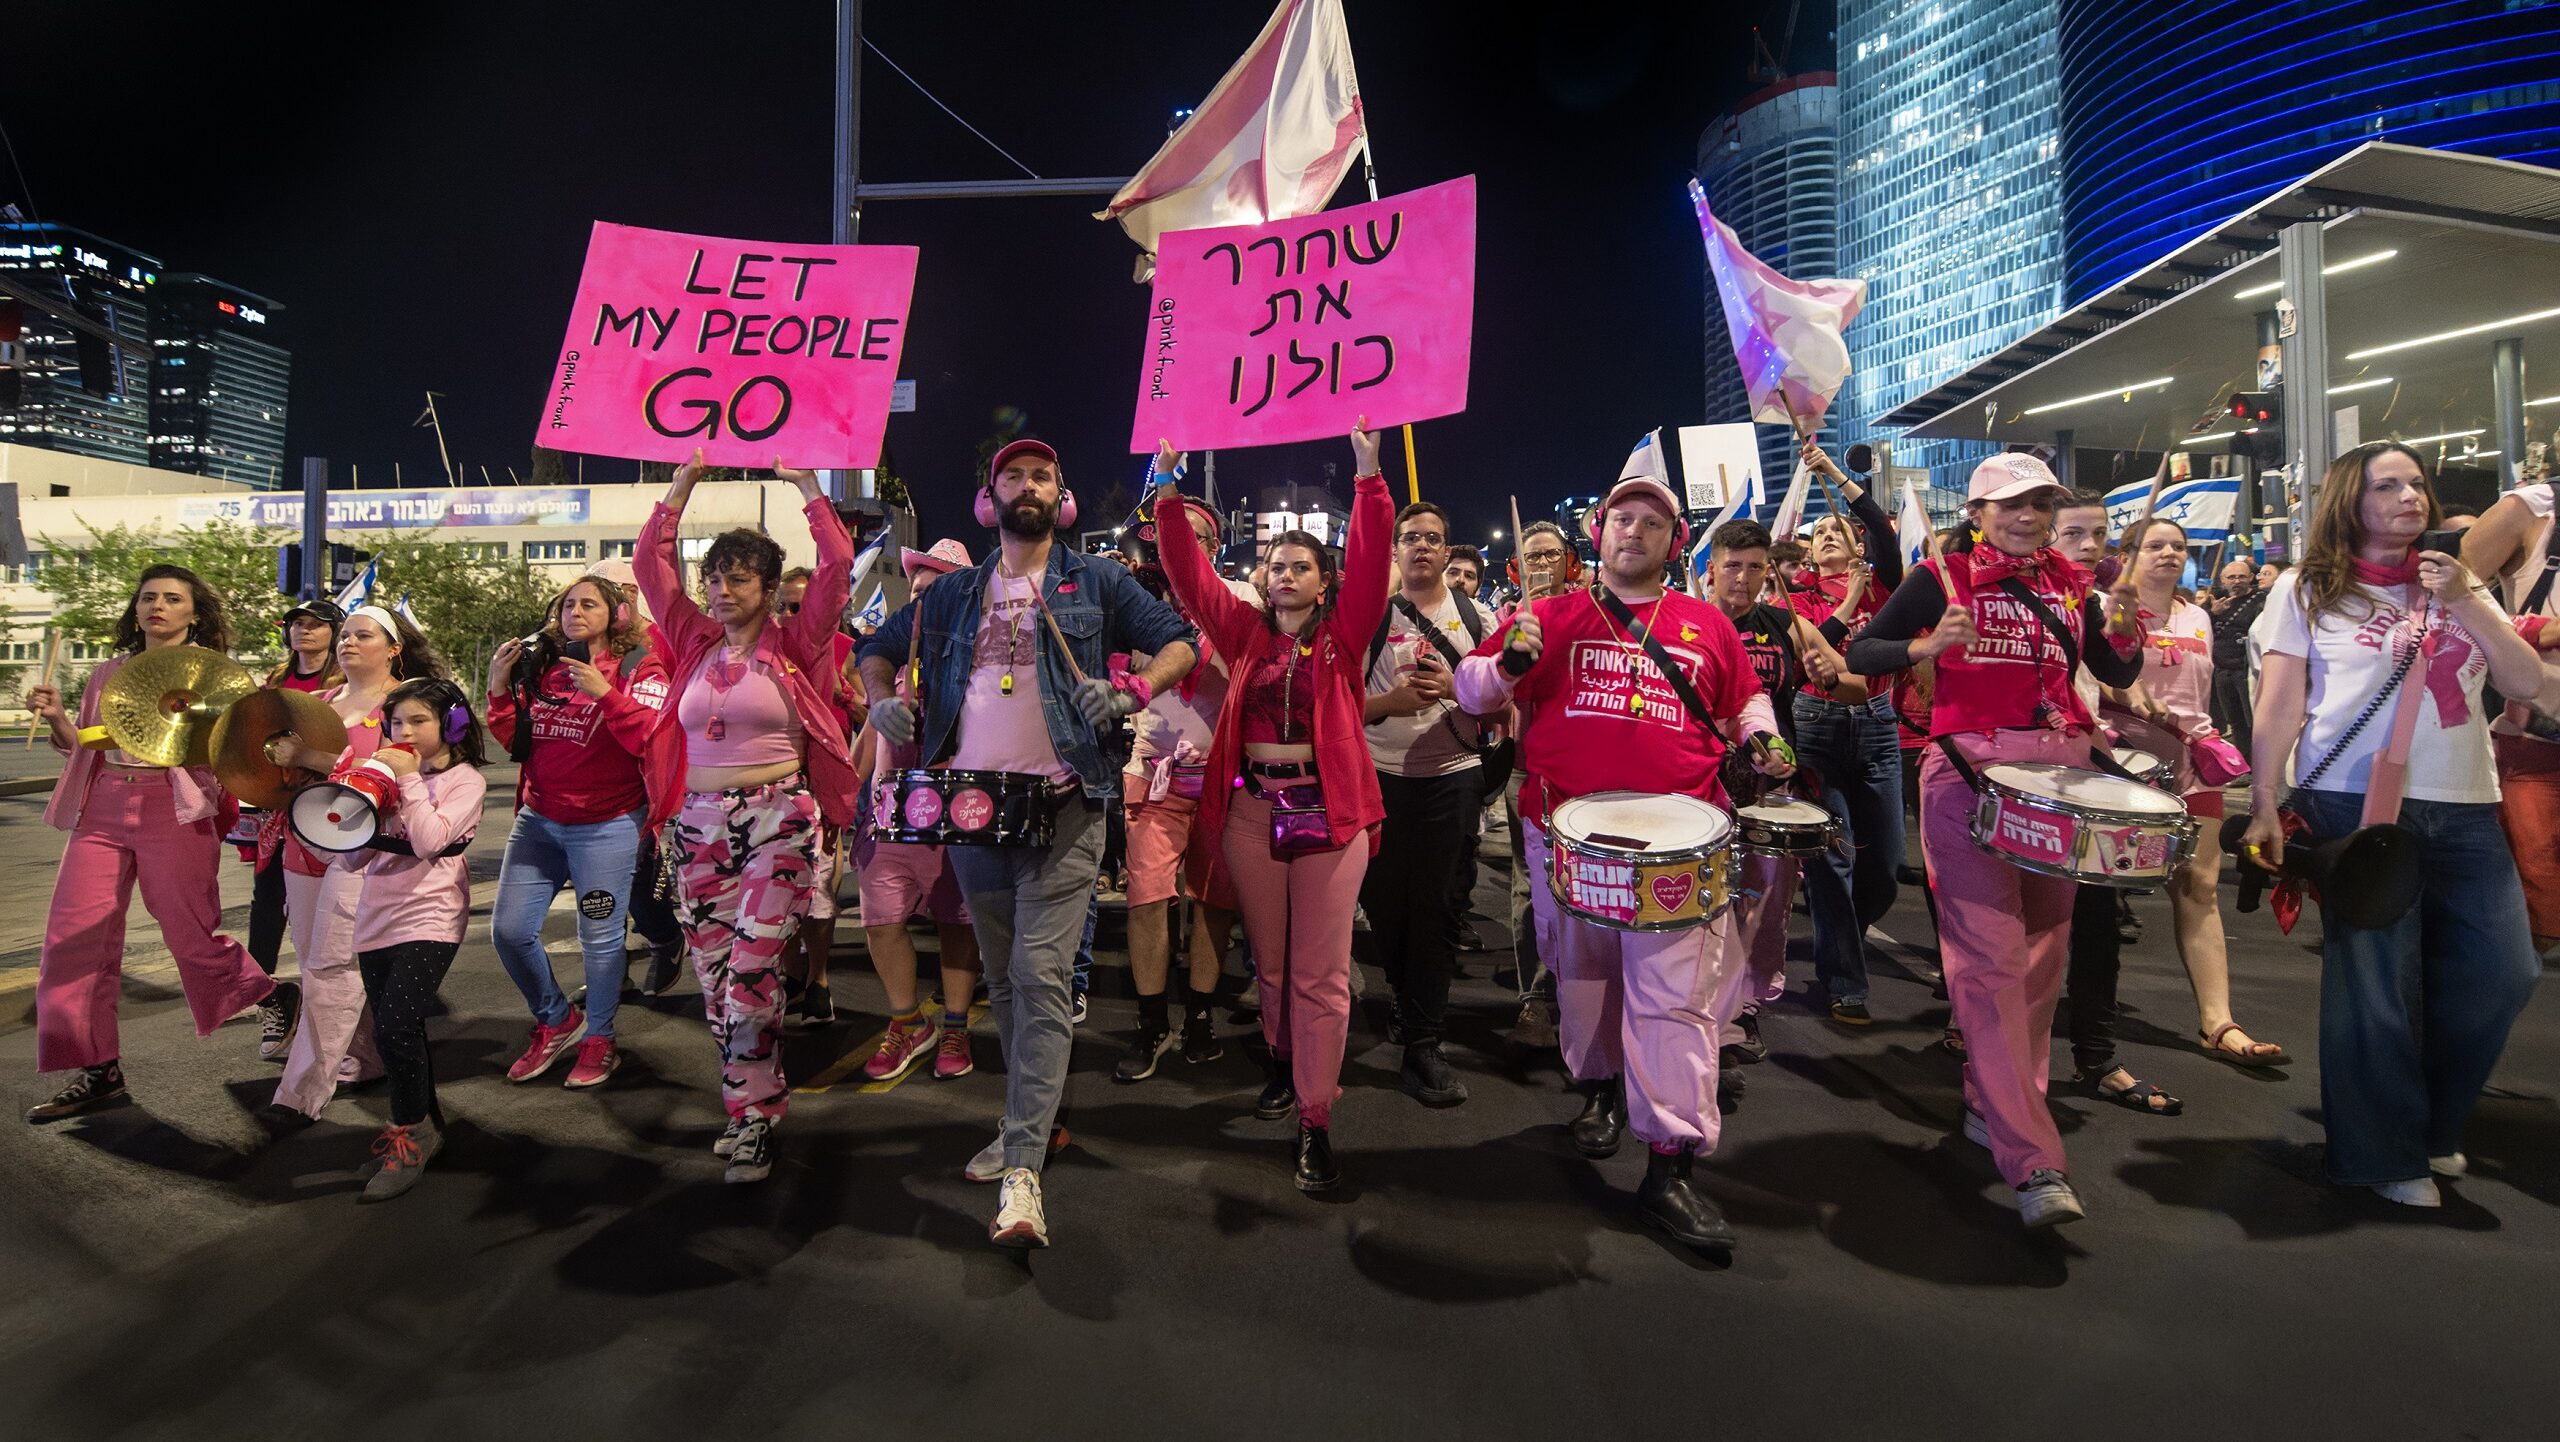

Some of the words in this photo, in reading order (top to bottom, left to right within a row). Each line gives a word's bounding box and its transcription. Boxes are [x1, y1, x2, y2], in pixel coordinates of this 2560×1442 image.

[1202, 211, 1404, 286] שחרר
[684, 248, 838, 302] LET
[1249, 279, 1352, 337] את
[591, 303, 681, 352] MY
[695, 308, 900, 361] PEOPLE
[1150, 297, 1177, 401] @pink.front
[1229, 334, 1396, 417] כולנו
[551, 350, 581, 430] @pink.front
[641, 367, 793, 442] GO
[219, 501, 241, 517] 75
[326, 499, 384, 522] באהב
[388, 499, 446, 521] שבחר
[453, 502, 482, 516] העם
[517, 501, 536, 514] לא
[1978, 637, 2032, 657] הורודה
[1581, 648, 1690, 683] PINKFROT
[1581, 671, 1630, 692] الوردية
[1575, 691, 1627, 711] הורודה
[1631, 699, 1677, 722] החזי
[1570, 862, 1635, 888] אנחנו
